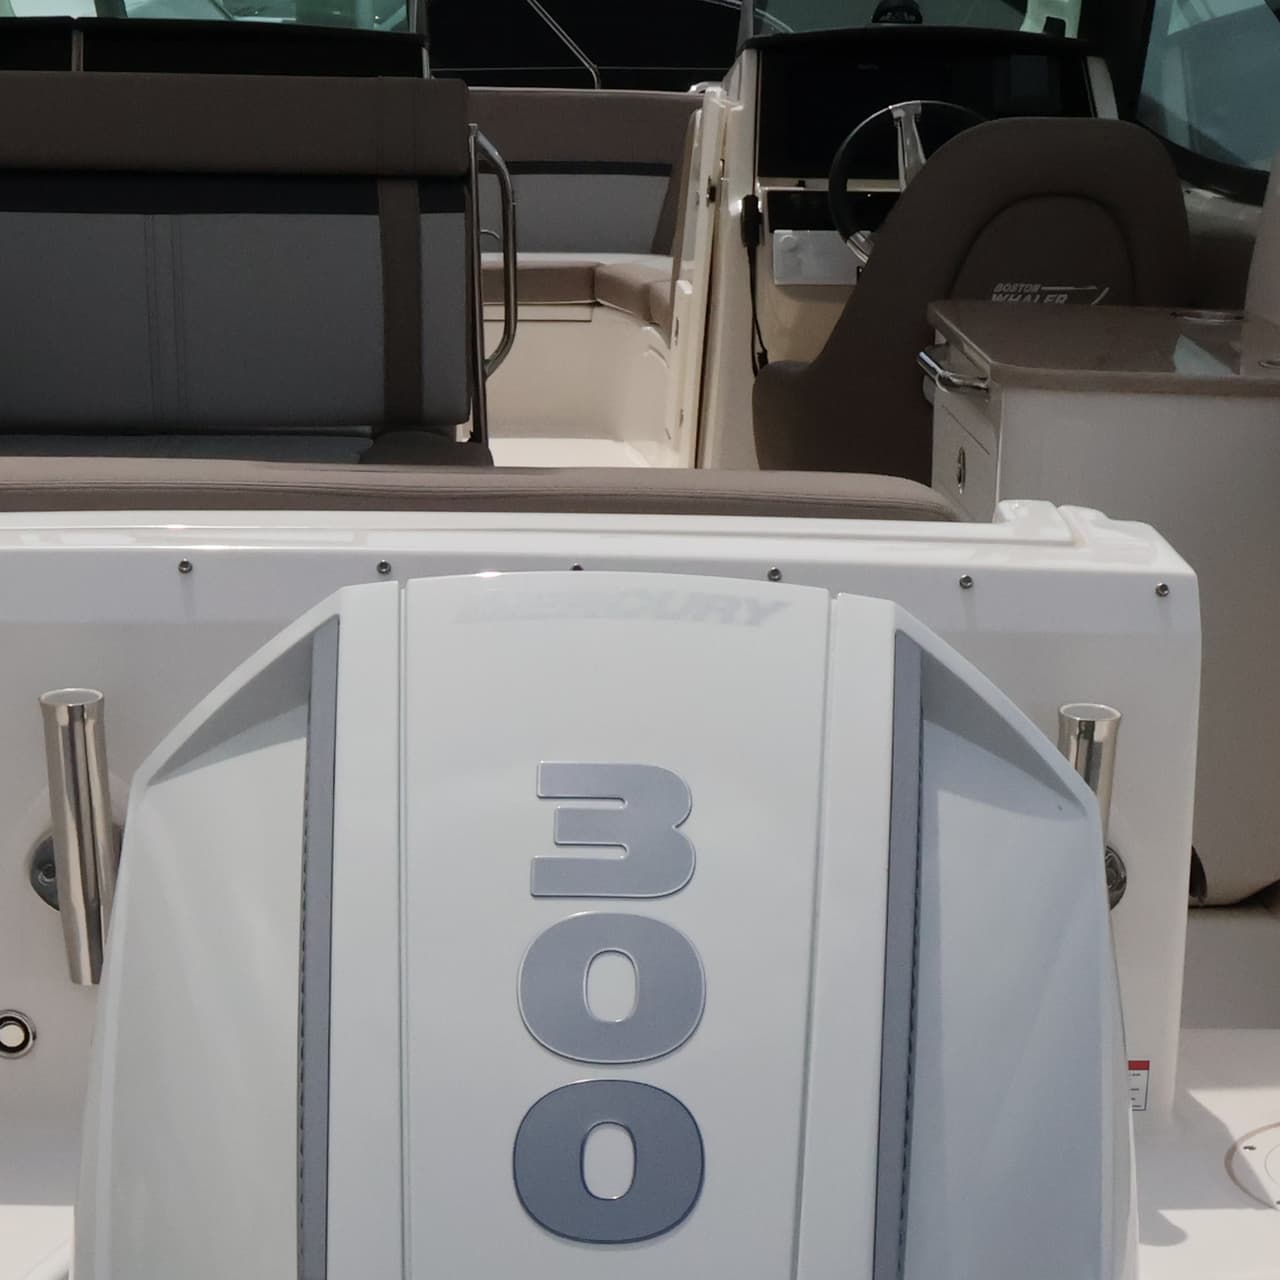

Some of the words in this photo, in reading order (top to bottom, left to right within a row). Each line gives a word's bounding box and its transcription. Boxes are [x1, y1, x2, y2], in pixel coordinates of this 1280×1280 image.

[992, 283, 1041, 293] BOSTON
[453, 588, 794, 627] ERCURY
[513, 760, 707, 1245] 300
